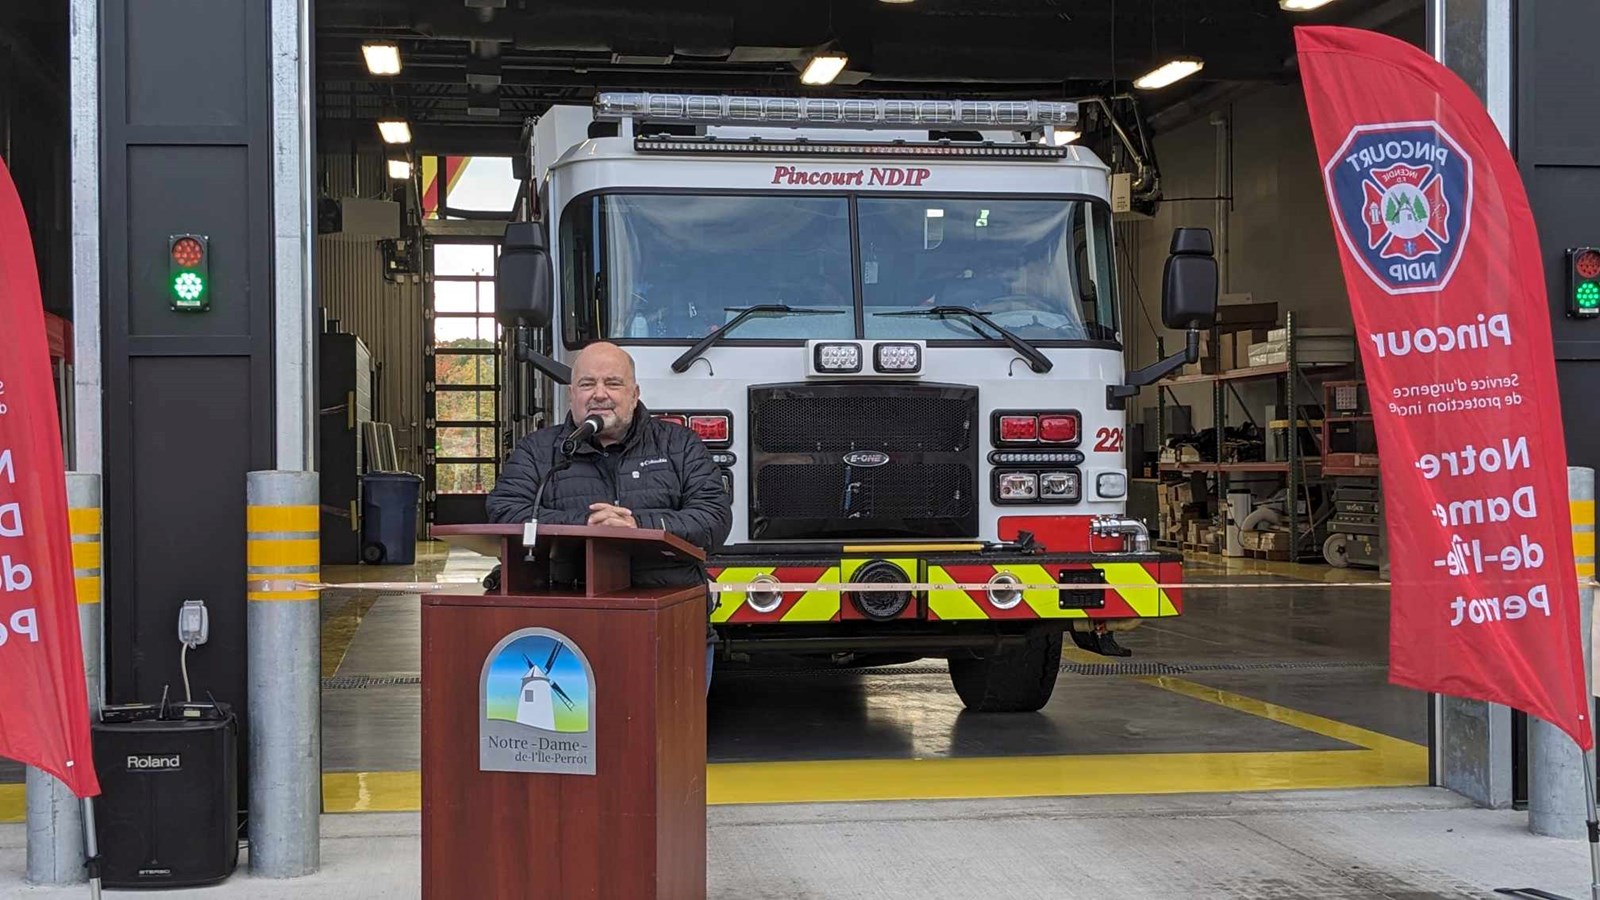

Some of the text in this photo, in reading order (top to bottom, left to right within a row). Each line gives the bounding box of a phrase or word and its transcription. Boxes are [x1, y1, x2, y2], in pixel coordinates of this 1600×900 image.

[771, 166, 931, 186] Pincourt NDIP
[850, 454, 881, 463] E-ONE
[127, 754, 180, 768] Roland
